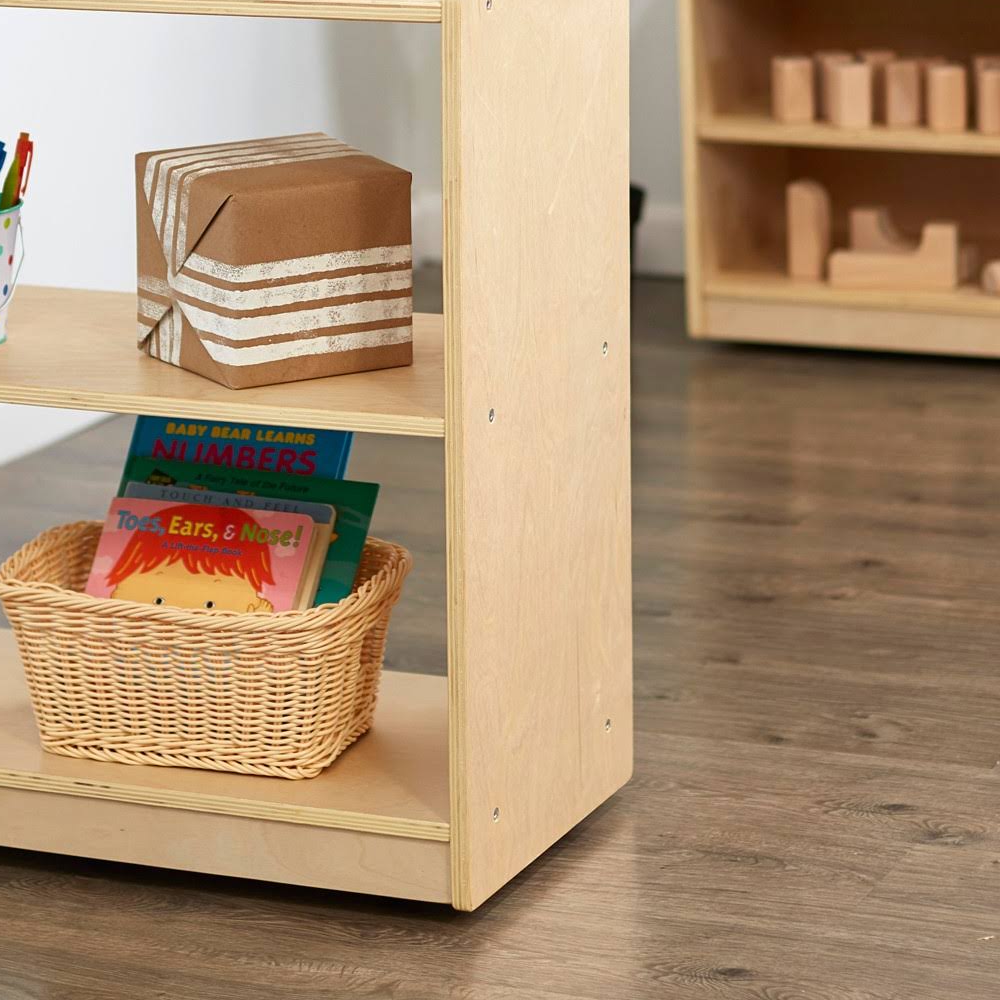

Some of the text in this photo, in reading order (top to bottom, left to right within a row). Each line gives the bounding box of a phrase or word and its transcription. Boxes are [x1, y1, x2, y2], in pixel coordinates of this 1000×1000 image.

[166, 422, 317, 446] BABY BEAR LEARNS
[151, 437, 318, 476] NUMBERS
[160, 489, 212, 504] TOUCH
[224, 496, 254, 508] AND
[117, 509, 304, 548] Toes, Ears, & Nose!
